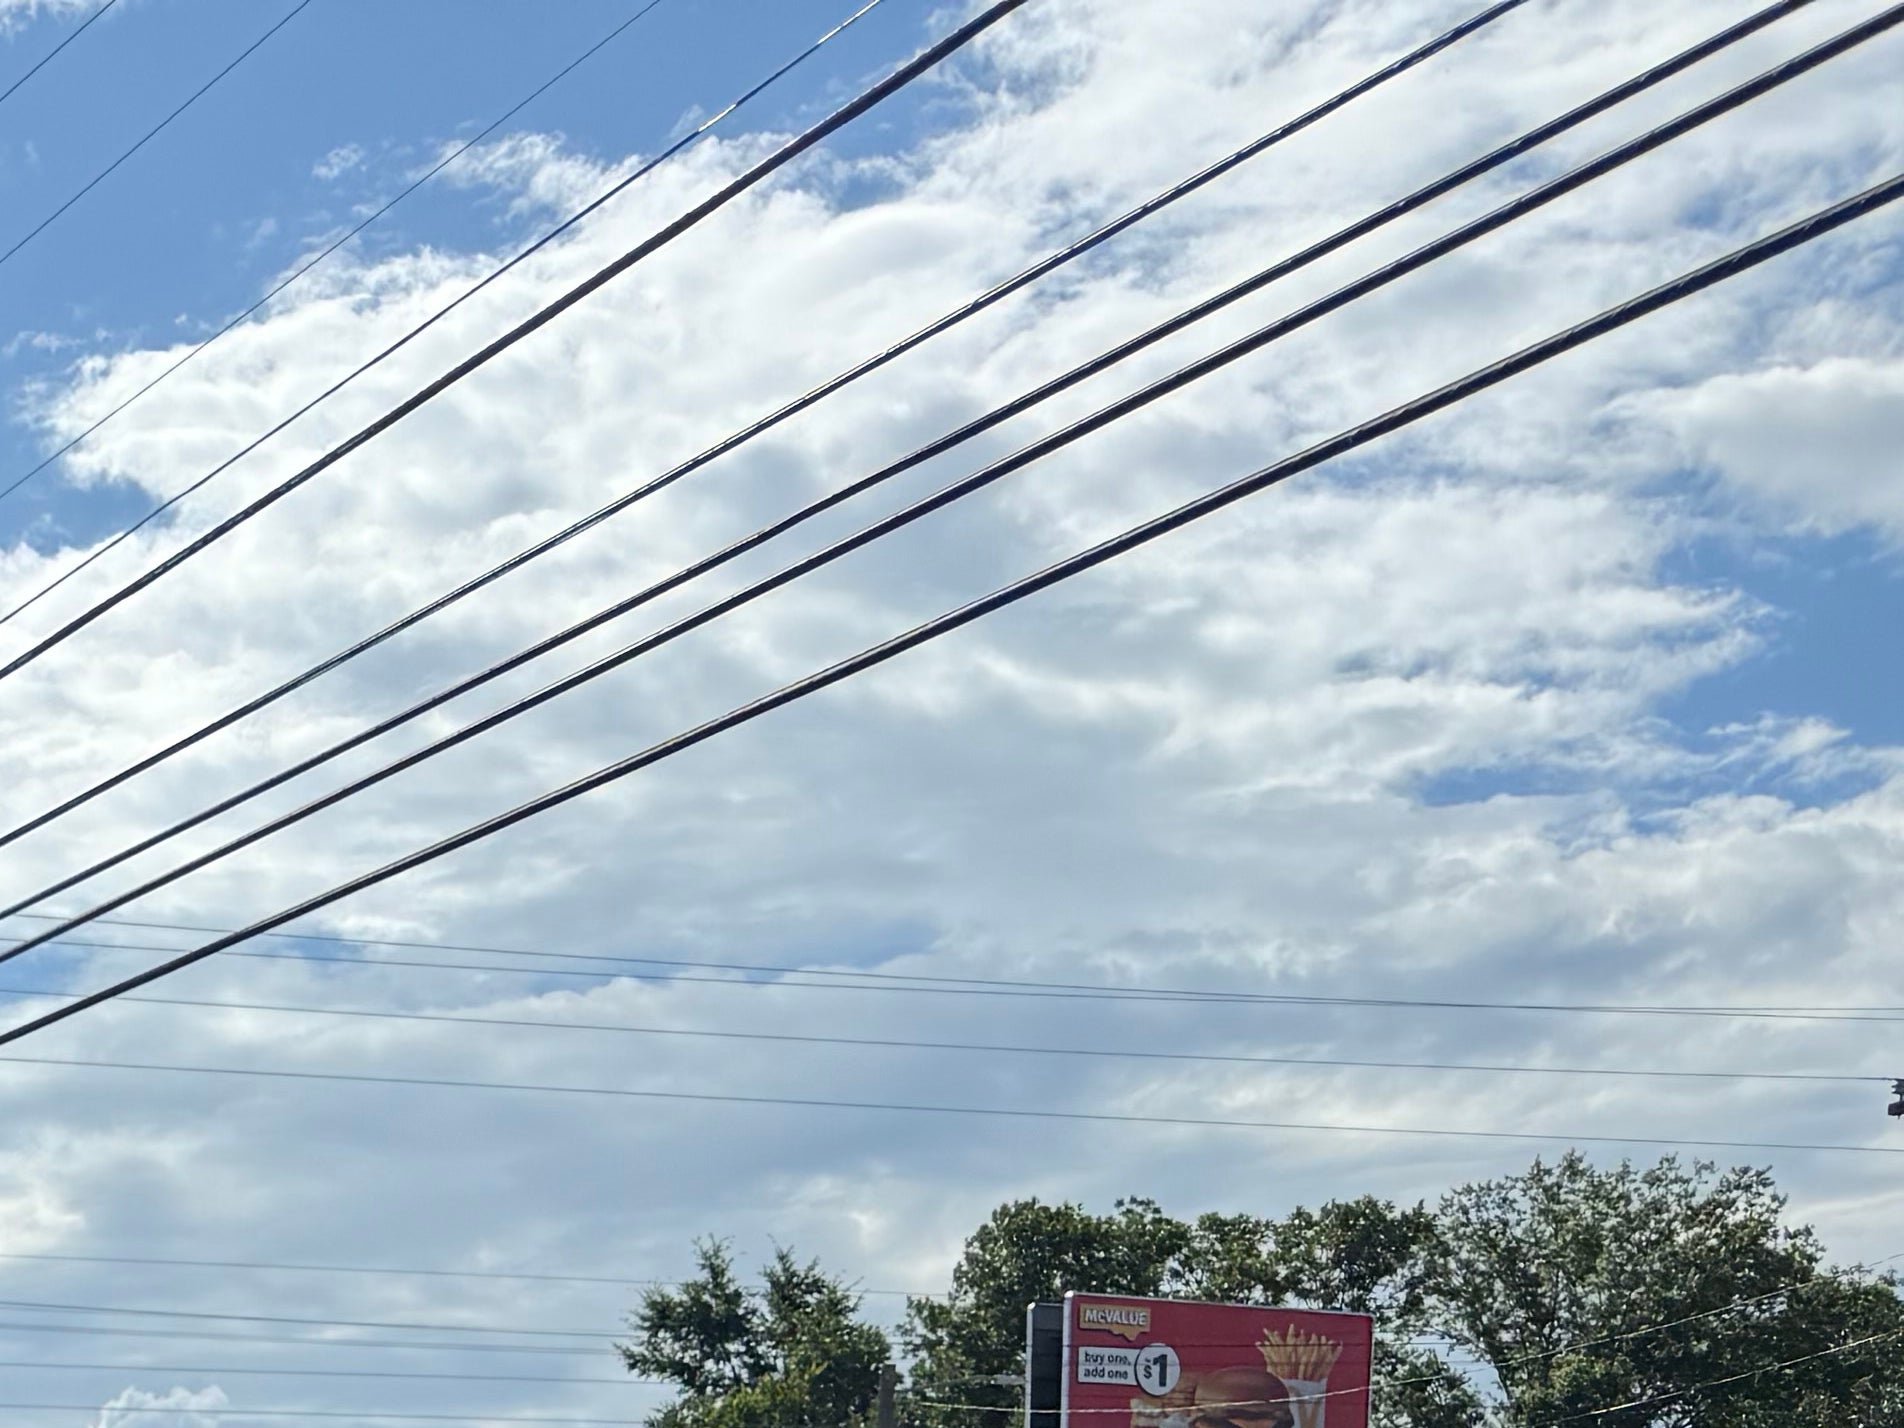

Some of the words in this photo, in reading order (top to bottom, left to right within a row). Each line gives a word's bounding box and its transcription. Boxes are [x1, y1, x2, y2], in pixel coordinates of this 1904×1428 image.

[1084, 1351, 1105, 1366] buy
[1083, 1367, 1105, 1378] add
[1107, 1369, 1128, 1380] one
[1143, 1354, 1168, 1387] $1
